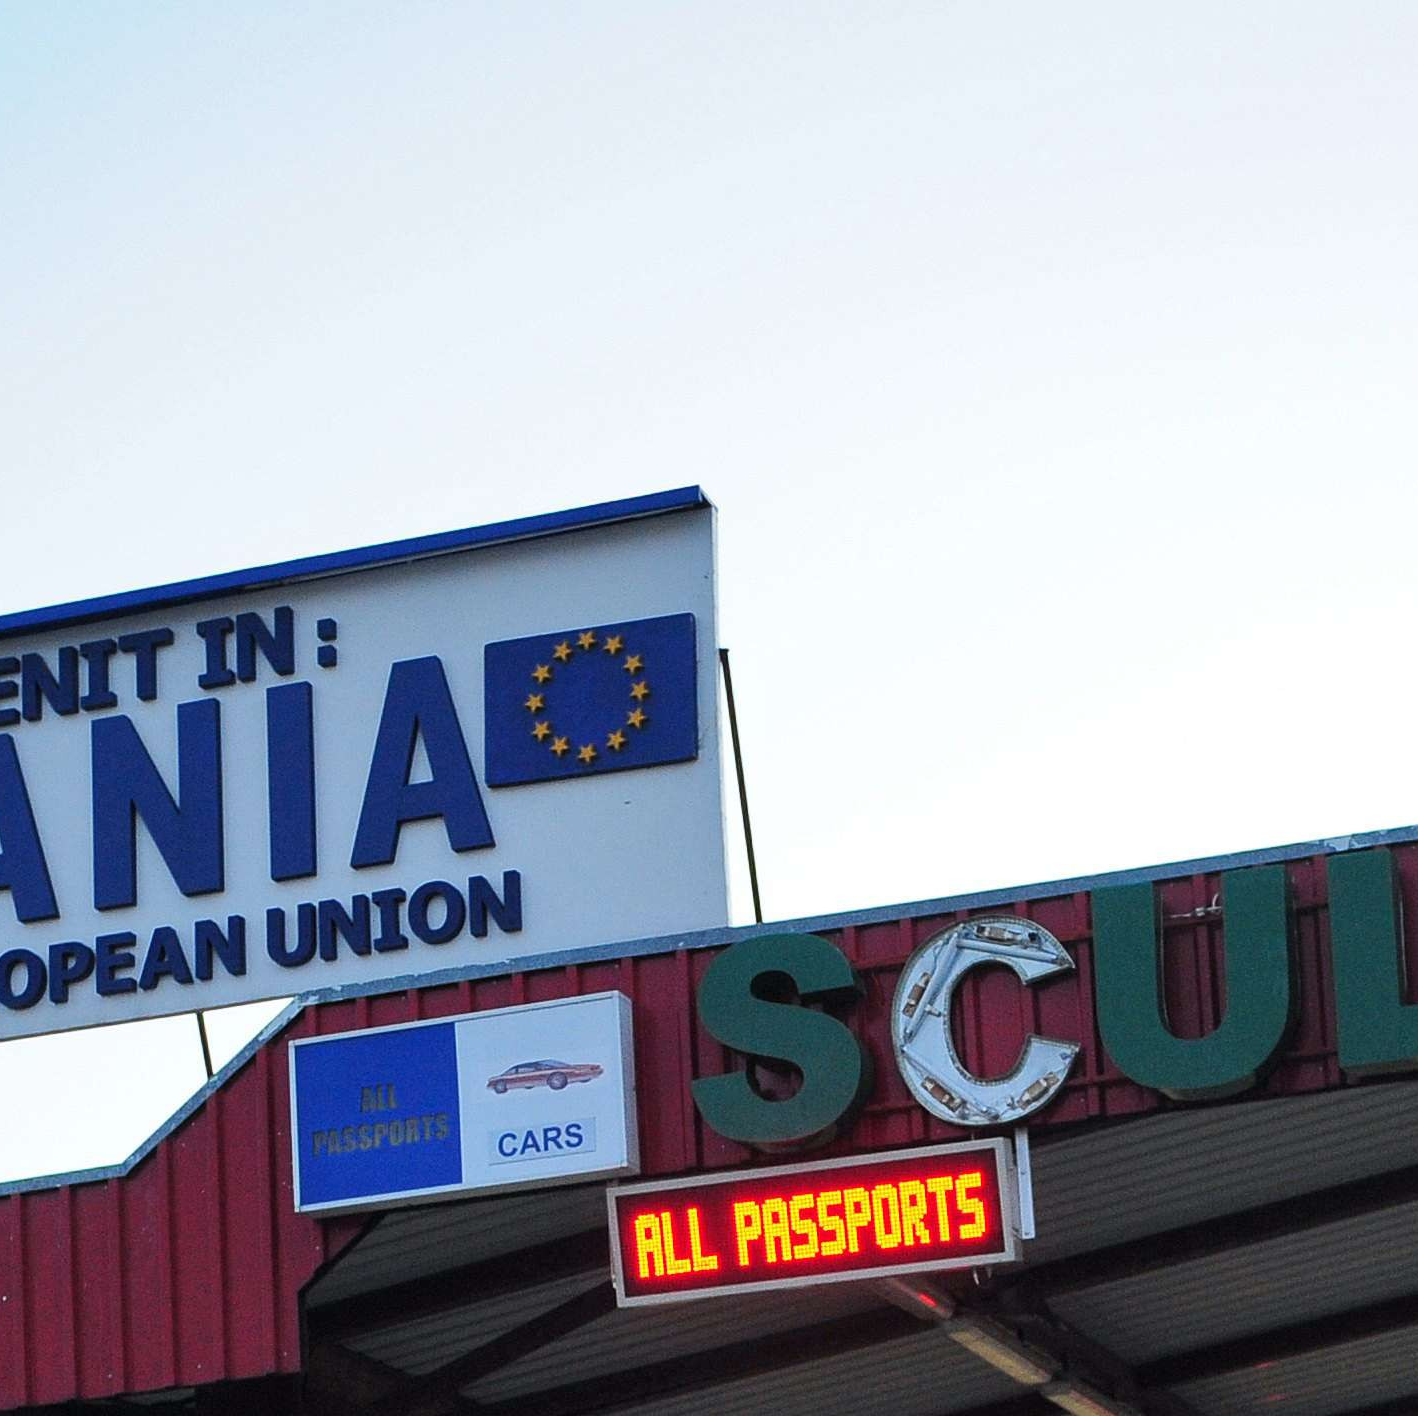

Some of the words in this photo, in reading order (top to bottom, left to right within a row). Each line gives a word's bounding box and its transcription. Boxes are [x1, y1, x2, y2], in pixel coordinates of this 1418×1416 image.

[266, 869, 522, 968] UNION
[359, 1082, 399, 1113] ALL
[312, 1112, 451, 1157] PASSPORTS
[497, 1123, 583, 1157] CARS
[632, 1209, 719, 1280] ALL
[733, 1170, 987, 1268] PASSPORTS
